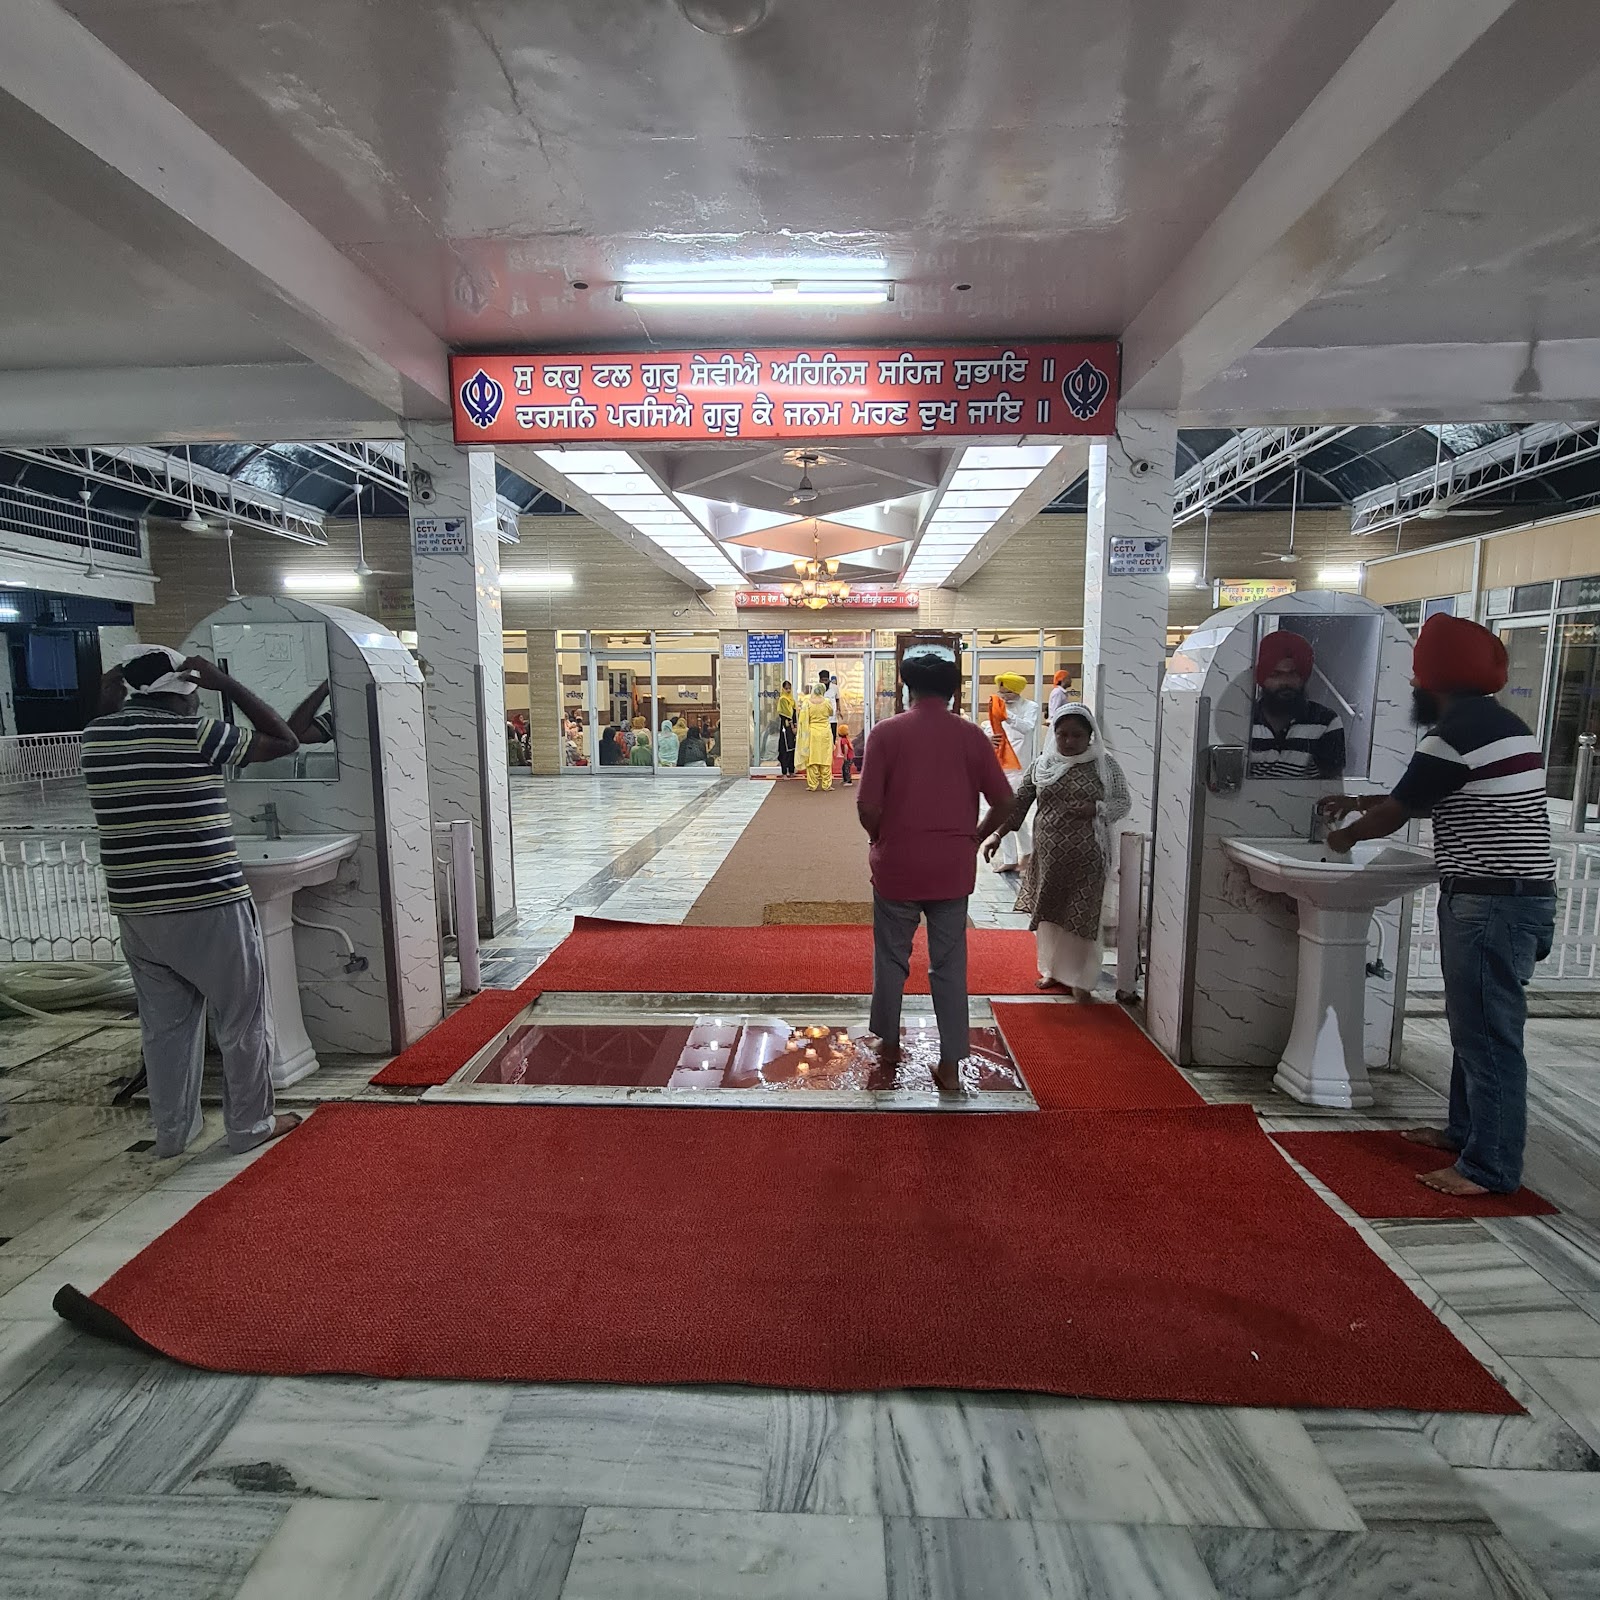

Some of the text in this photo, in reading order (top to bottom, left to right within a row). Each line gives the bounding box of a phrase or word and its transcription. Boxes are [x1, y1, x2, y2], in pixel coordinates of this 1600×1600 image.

[514, 365, 533, 395] ਸੁ
[543, 365, 582, 394] ਕਹੁ
[592, 364, 631, 388] ਟਲ
[641, 363, 681, 393] ਗੁਰੁ
[690, 352, 761, 387] ਸੇਵੀਐ
[771, 353, 868, 386] ਅਹਿਨਿਸ
[878, 352, 944, 385] ਸਹਿਜ
[954, 350, 1028, 390] ਸੁਭਾਇ
[516, 395, 597, 429] ਦਰਸਨਿ
[606, 393, 693, 429] ਪਰਸਿਐ
[703, 402, 743, 437] ਗੁਰੂ
[752, 393, 774, 426] ਕੈ
[783, 402, 842, 426] ਜਨਮ
[851, 401, 909, 425] ਮਰਣ
[918, 401, 957, 431] ਦੁਖ
[968, 392, 1023, 424] ਜਾਇ
